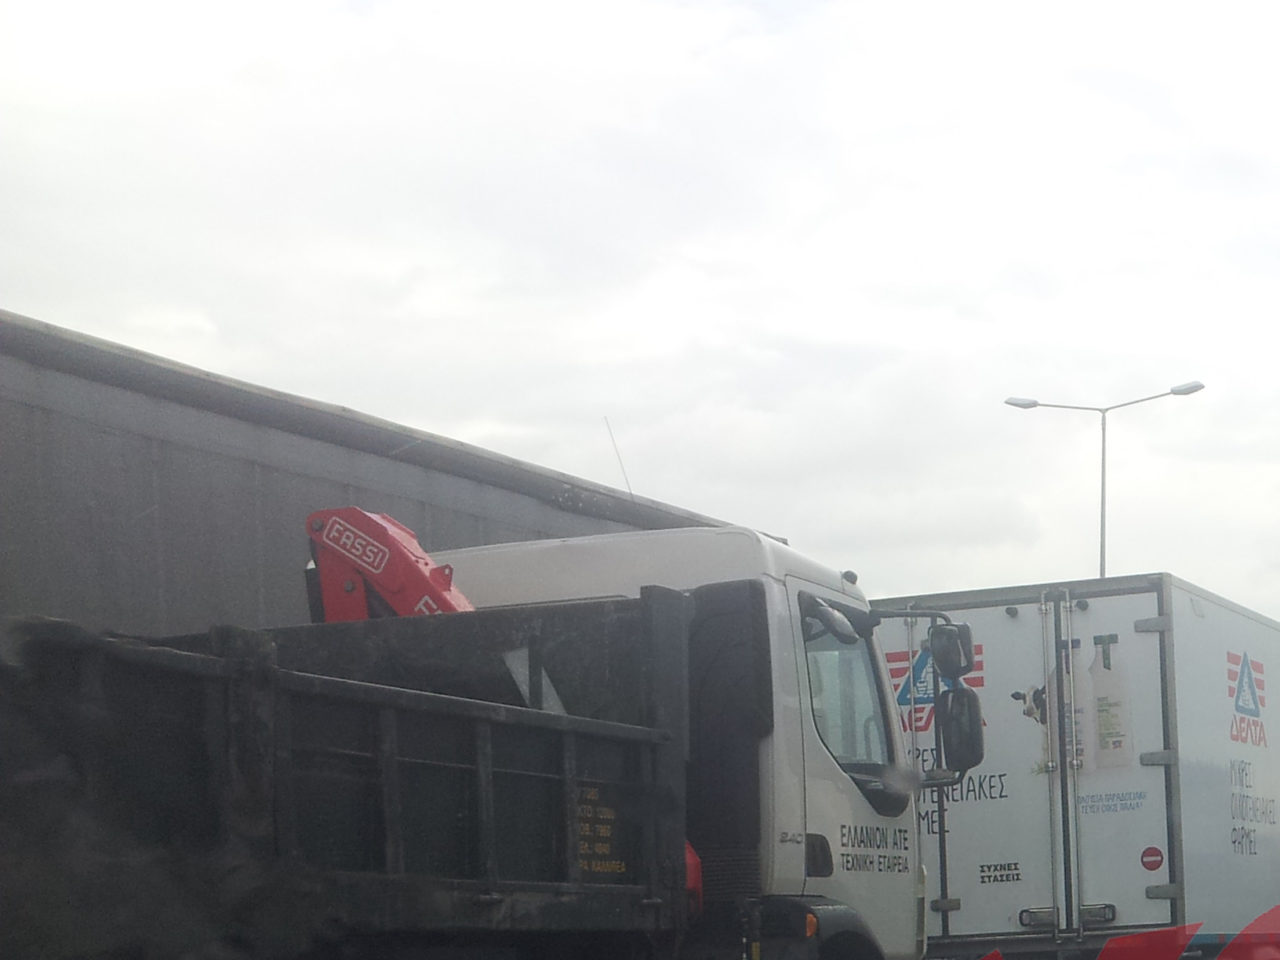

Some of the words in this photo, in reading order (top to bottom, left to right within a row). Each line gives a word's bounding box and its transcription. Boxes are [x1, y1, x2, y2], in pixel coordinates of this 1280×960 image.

[329, 524, 383, 567] FASSI
[1230, 714, 1268, 748] ΔΕΛΤΑ
[841, 824, 888, 849] ΕΛΛΑΝΙΟΝ
[892, 829, 909, 851] ΑΤΕ
[841, 853, 875, 872] ΤΕΧΝΙΚΗ
[878, 855, 909, 873] ΕΤΑΙΡΕΙΑ
[979, 862, 1020, 873] ΣΥΧΝΕΣ
[980, 872, 1022, 884] ΣΤΑΣΕΙΣ
